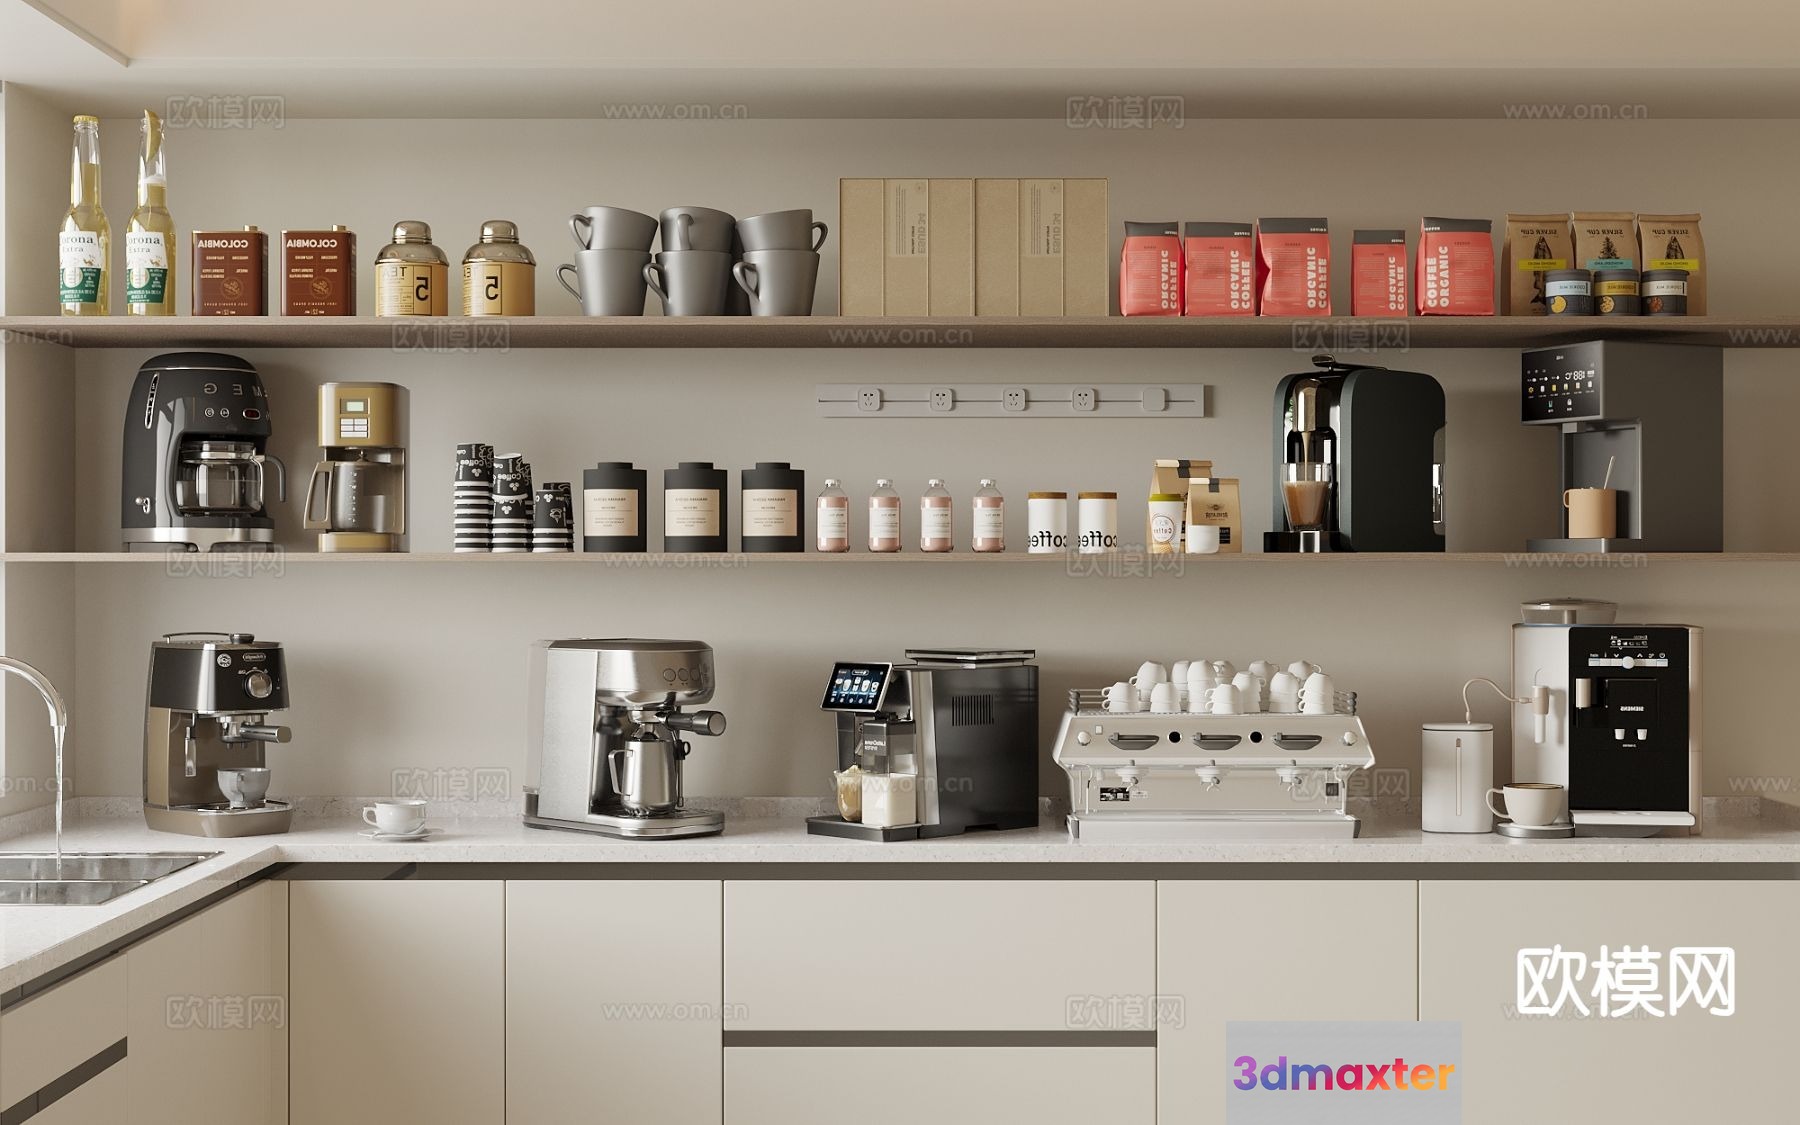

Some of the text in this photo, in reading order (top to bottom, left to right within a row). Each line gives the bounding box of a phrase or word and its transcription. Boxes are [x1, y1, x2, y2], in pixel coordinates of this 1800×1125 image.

[62, 236, 94, 244] orona
[128, 236, 160, 244] orona
[1427, 257, 1437, 308] COFFEE
[1438, 246, 1449, 308] ORGANIC
